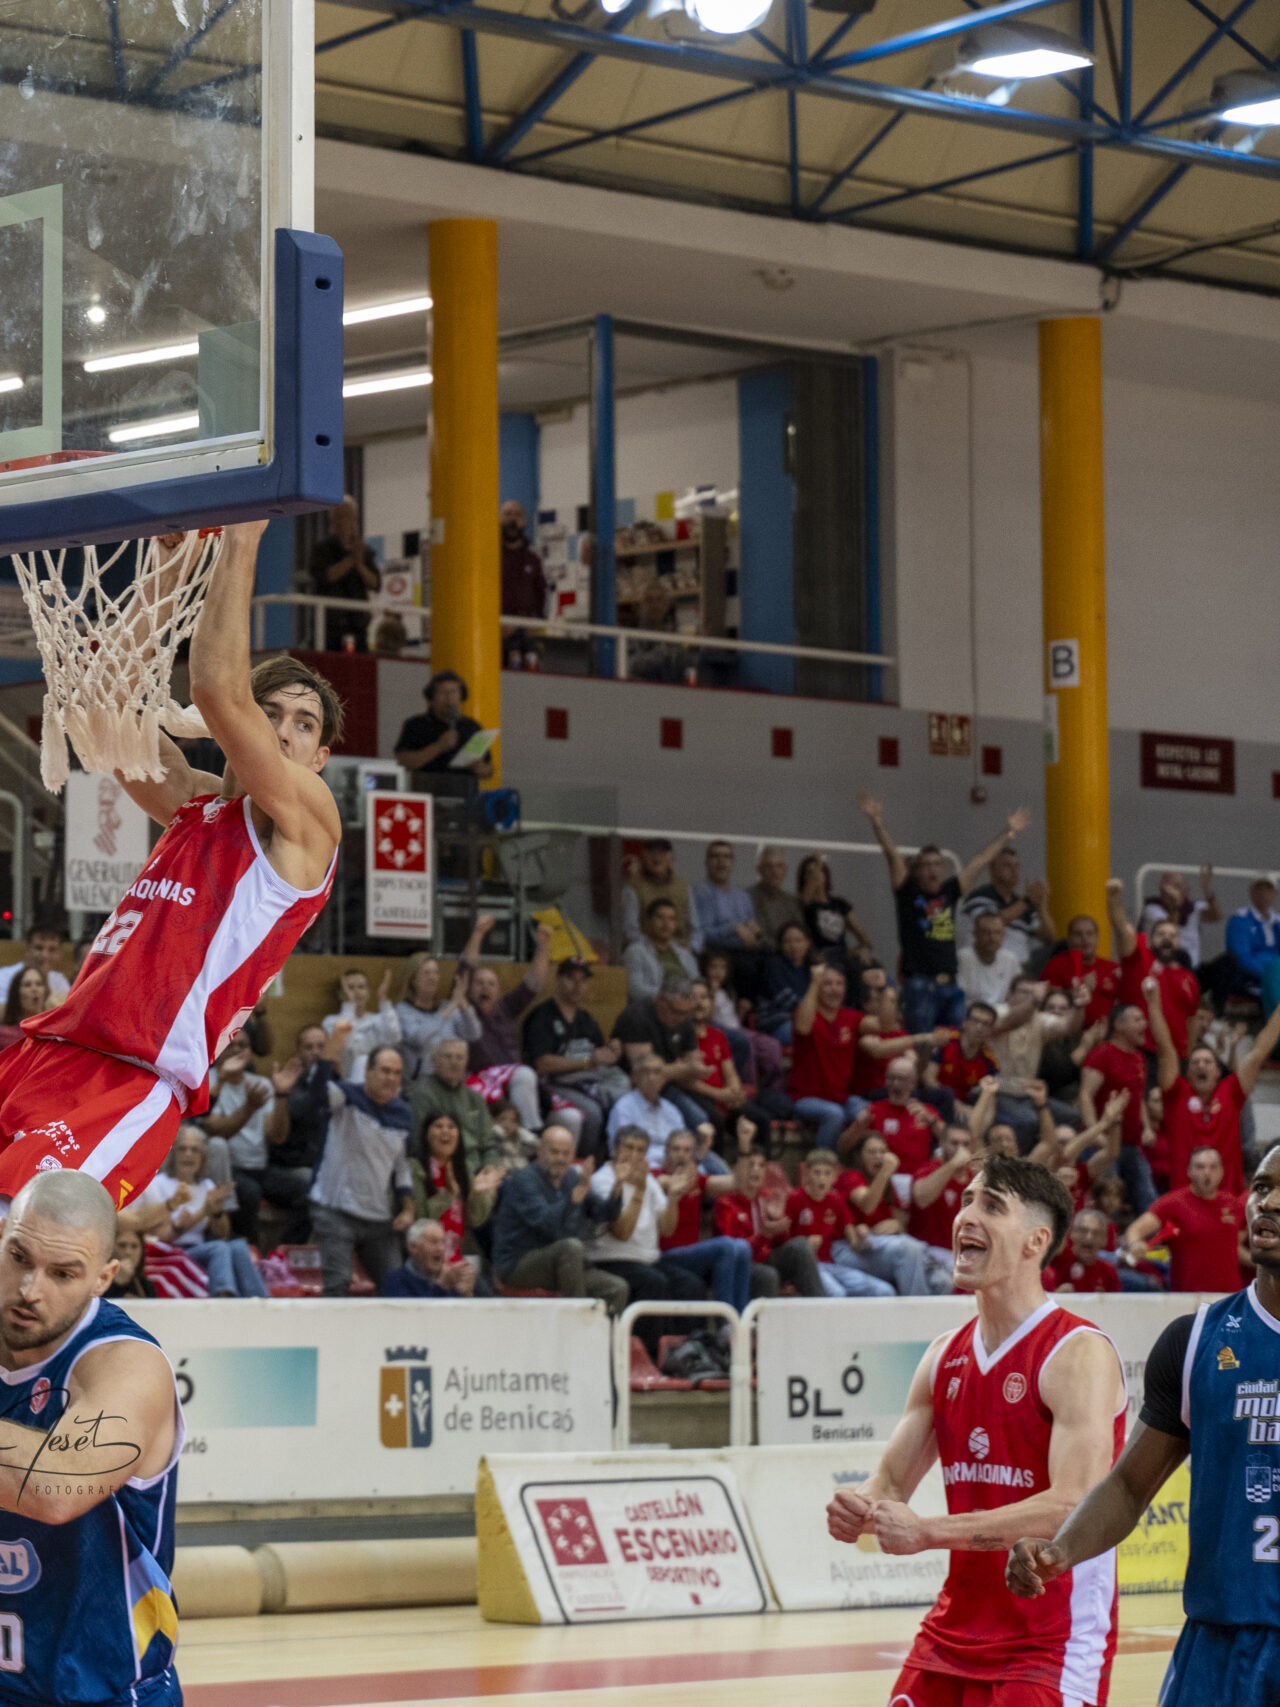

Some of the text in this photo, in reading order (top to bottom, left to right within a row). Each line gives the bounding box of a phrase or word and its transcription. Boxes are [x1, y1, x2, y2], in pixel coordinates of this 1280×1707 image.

[1052, 645, 1074, 678] B
[444, 1366, 569, 1400] Ajuntamet
[1237, 1380, 1277, 1395] ciudad
[443, 1403, 473, 1431] de
[813, 1423, 874, 1440] Benicarló
[625, 1488, 704, 1522] CASTELLÓN
[614, 1528, 738, 1563] ESCENARIO
[646, 1566, 721, 1588] DEPORTIVO
